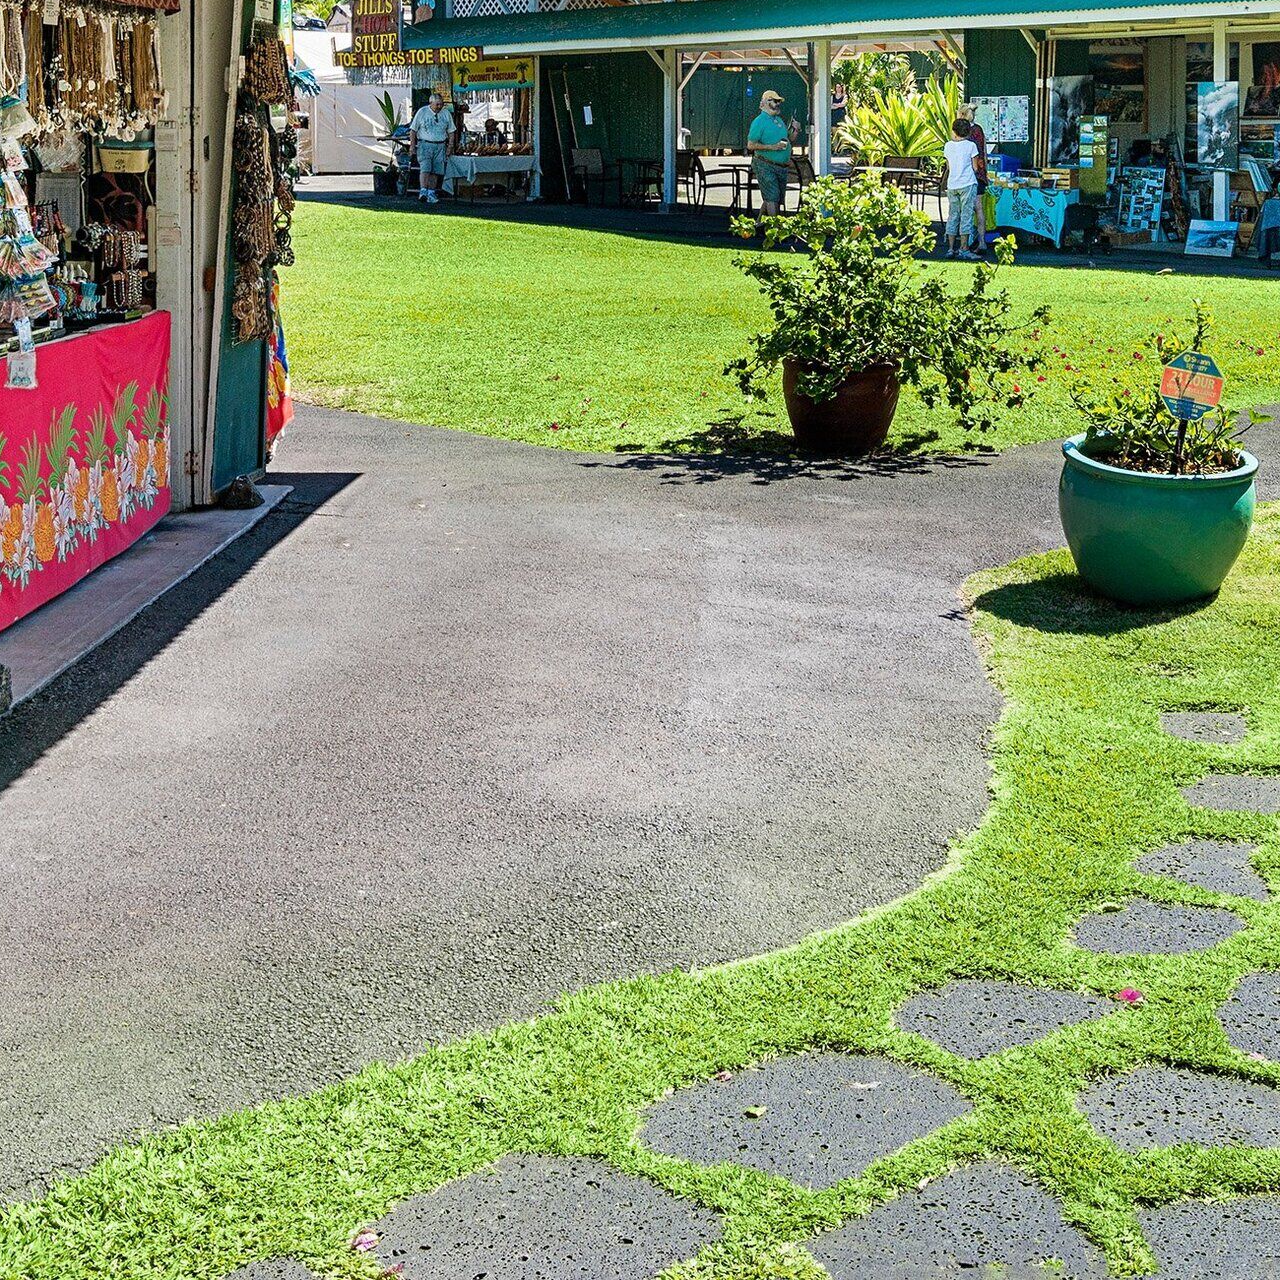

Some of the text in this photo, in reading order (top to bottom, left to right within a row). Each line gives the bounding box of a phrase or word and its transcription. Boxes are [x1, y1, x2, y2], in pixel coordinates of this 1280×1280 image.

[362, 15, 388, 33] HOT
[354, 33, 397, 53] STUFF
[337, 47, 478, 67] TOE THONGS TOE RINGS
[492, 72, 517, 81] POSTCARD
